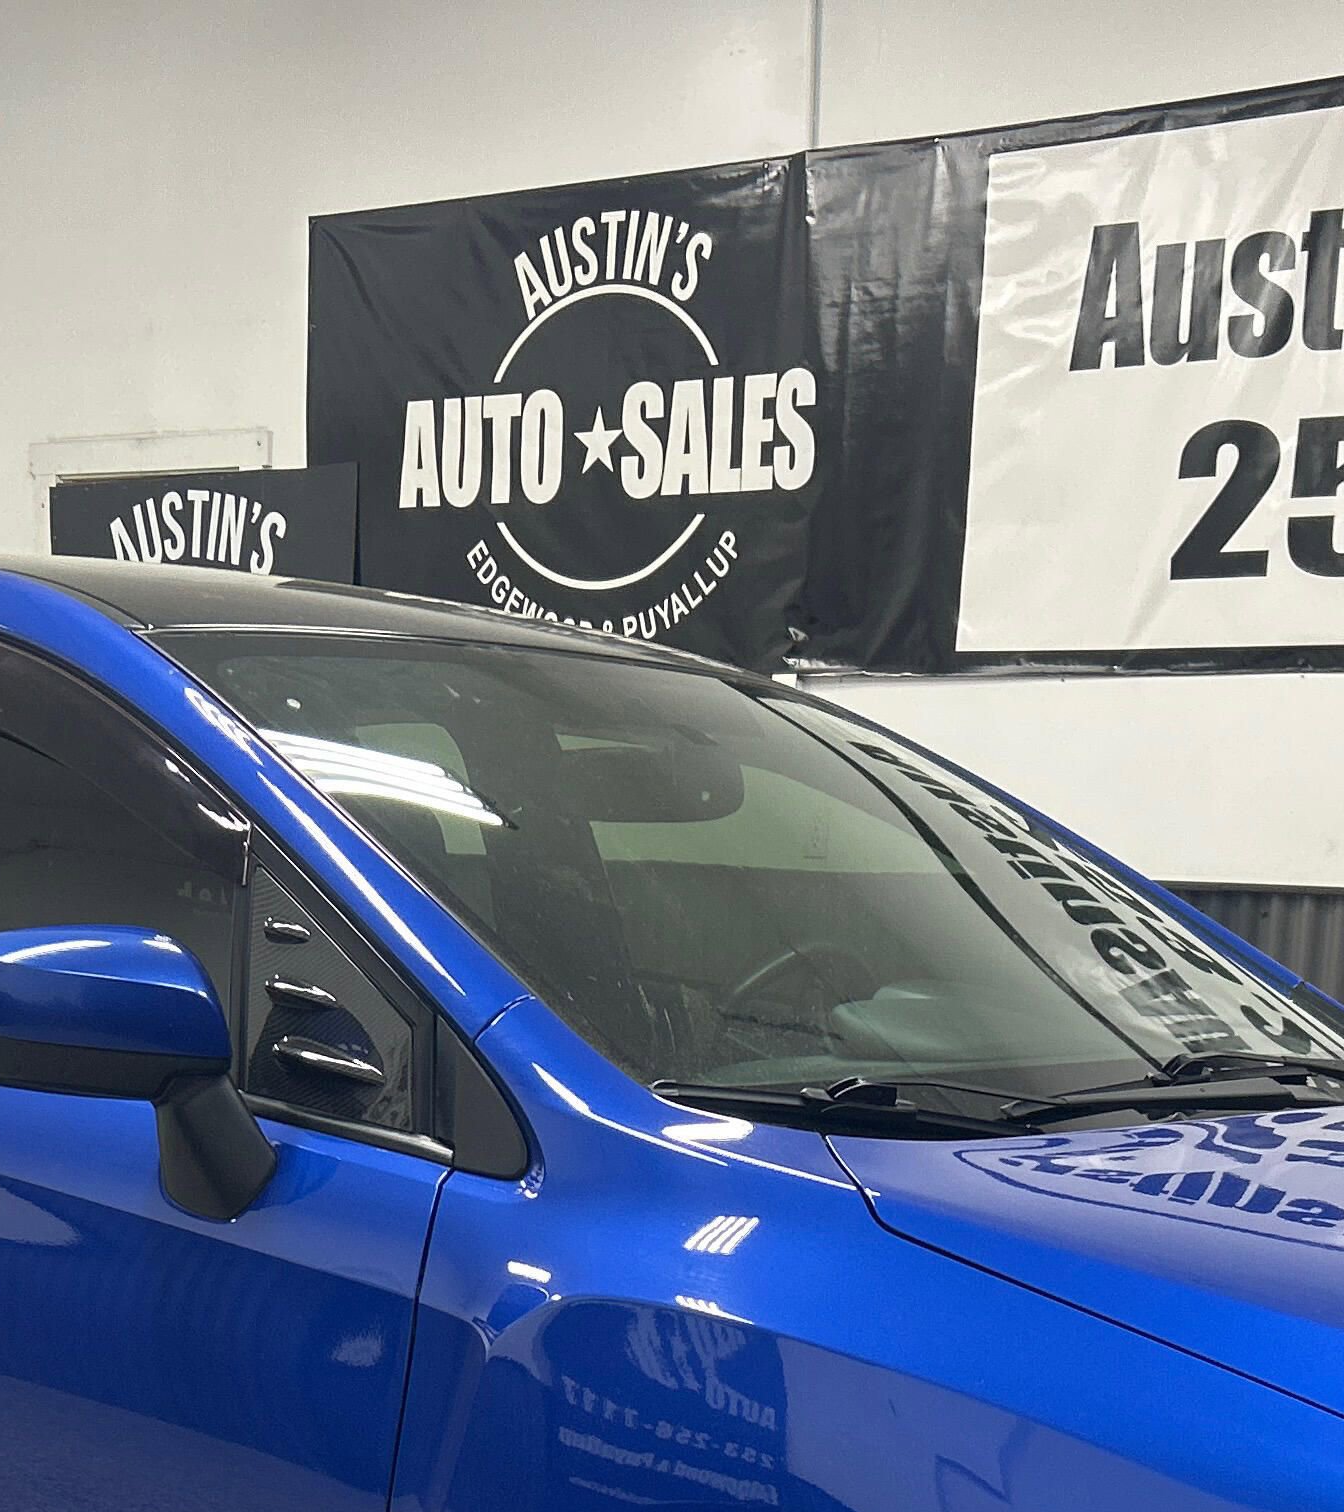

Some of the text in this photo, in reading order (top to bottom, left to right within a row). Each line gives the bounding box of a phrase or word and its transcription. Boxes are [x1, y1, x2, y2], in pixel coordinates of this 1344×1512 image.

[513, 209, 713, 321] AUSTIN'S
[398, 366, 818, 510] AUTO SALES
[109, 488, 287, 576] AUSTIN'S
[622, 530, 738, 640] PUYALLUP
